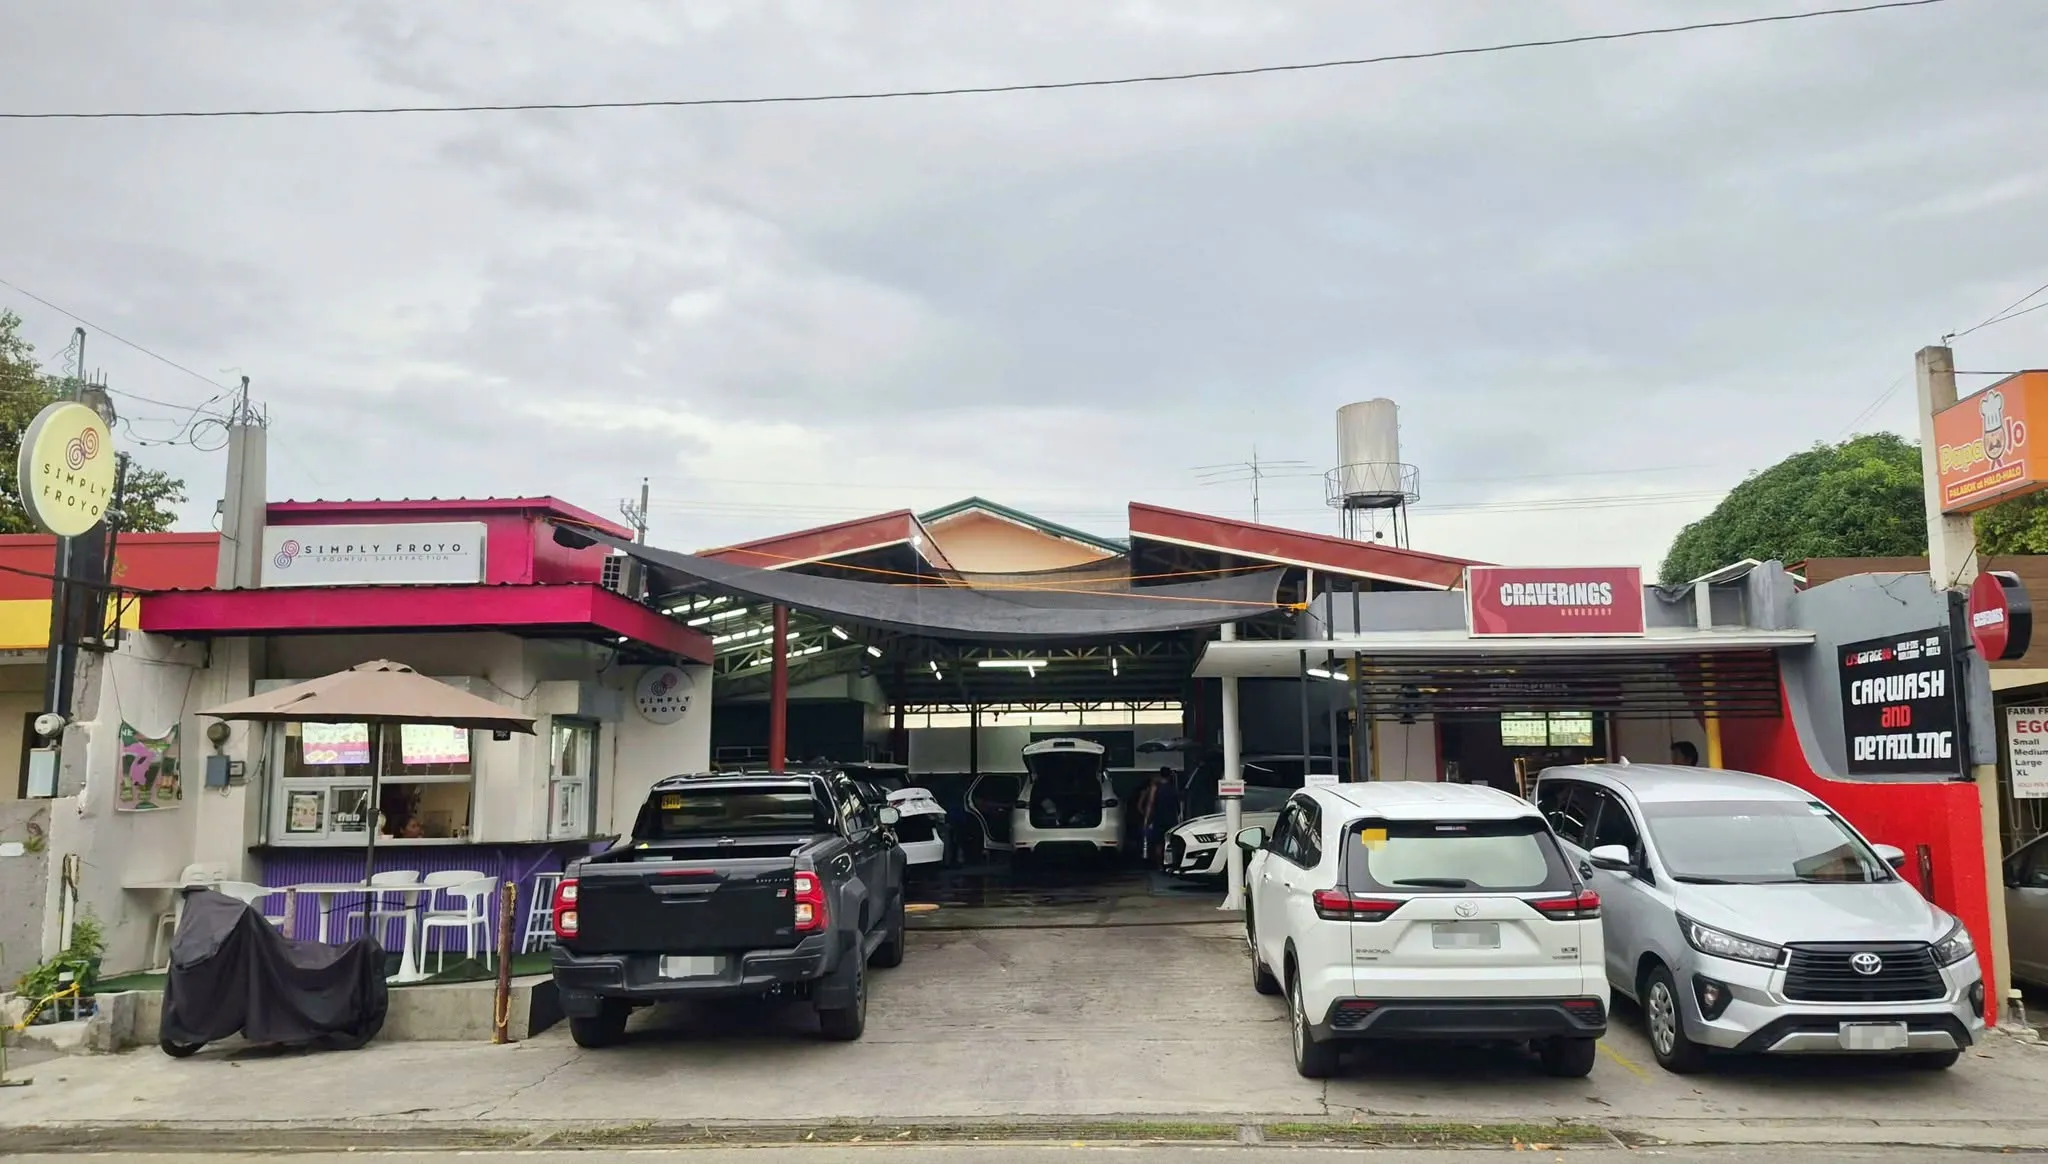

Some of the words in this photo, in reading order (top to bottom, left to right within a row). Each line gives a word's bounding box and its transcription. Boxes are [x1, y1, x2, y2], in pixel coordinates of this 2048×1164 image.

[1940, 439, 1985, 474] Papa
[43, 463, 107, 497] SIMPLY
[1983, 466, 2022, 488] HALO-HALO
[43, 485, 99, 516] FROYO
[304, 543, 381, 554] SIMPLY
[396, 543, 462, 553] FROYO
[316, 555, 369, 563] SPOONFUL
[375, 554, 450, 562] SATISFACTION
[1500, 582, 1612, 606] CRAVERINGS
[1851, 669, 1945, 705] CARWASH
[640, 696, 690, 704] SIMPLY
[2007, 707, 2035, 715] FARM
[2013, 738, 2040, 746] Small
[2015, 760, 2042, 768] Large
